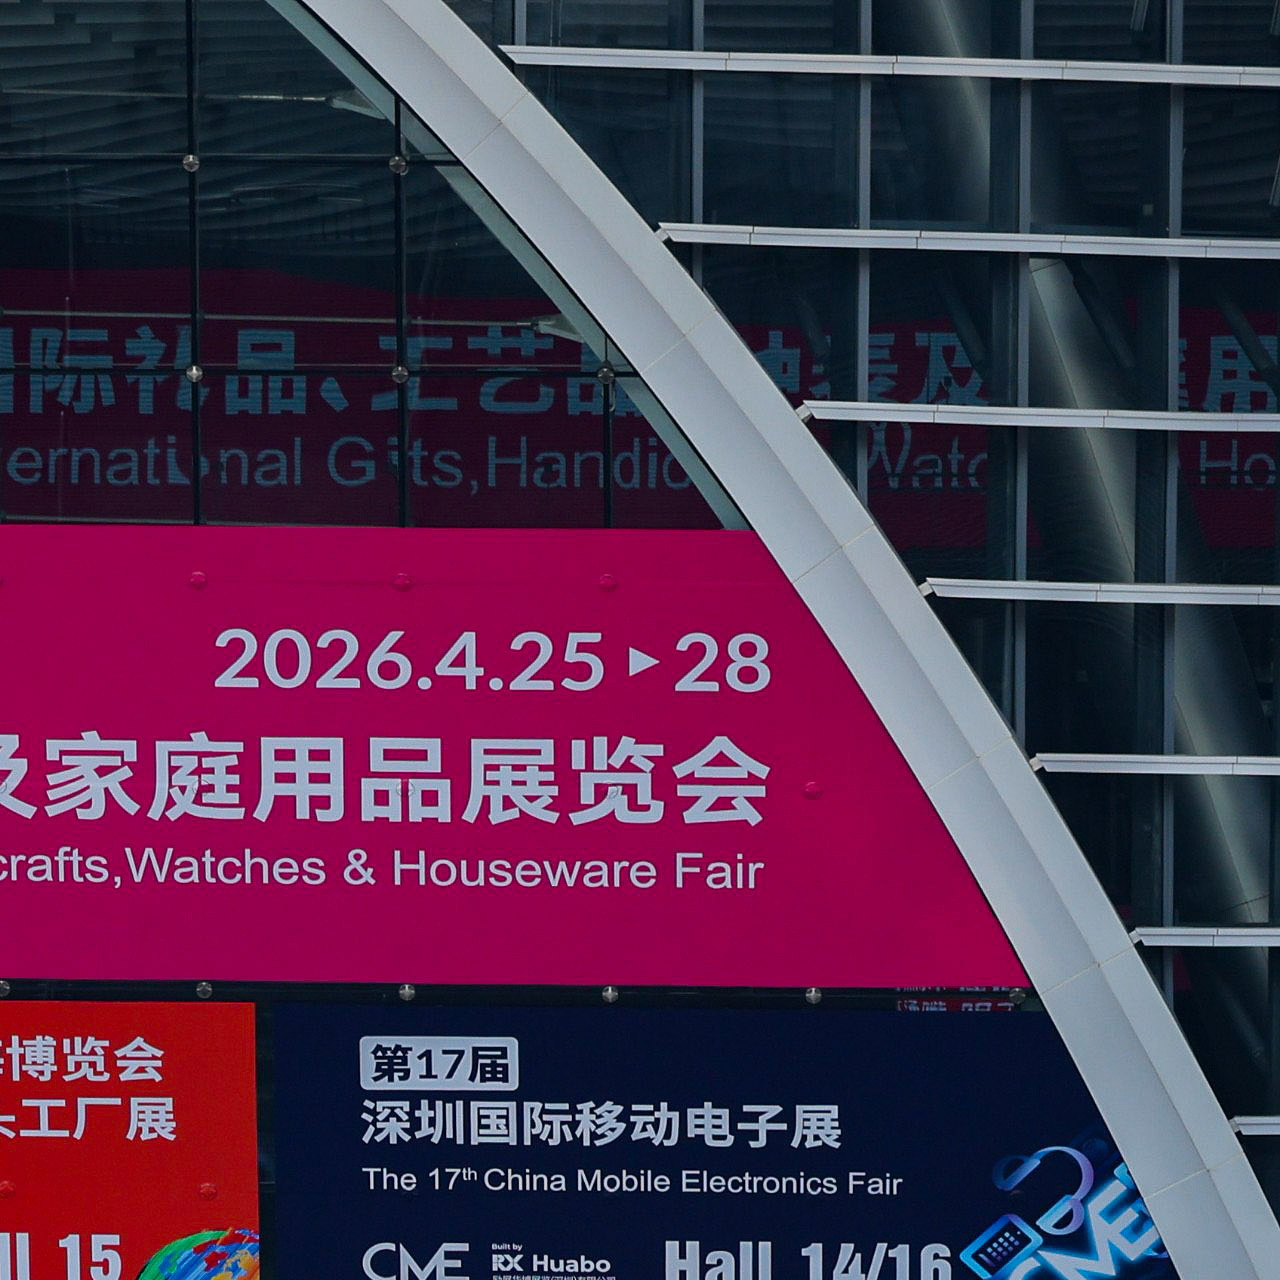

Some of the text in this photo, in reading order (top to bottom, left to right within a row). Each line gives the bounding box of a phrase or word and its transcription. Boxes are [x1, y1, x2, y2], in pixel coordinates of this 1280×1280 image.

[214, 629, 771, 694] 2026.4.25 28
[343, 849, 376, 886] &
[392, 847, 655, 889] Houseware
[675, 852, 765, 889] Fair
[369, 1042, 511, 1084] 第17届
[360, 1099, 843, 1150] 深圳国际移动电子展
[362, 1166, 903, 1196] The 17th China Mobile Electronics Fair
[491, 1242, 523, 1252] Built by
[492, 1254, 612, 1274] RX Huabo
